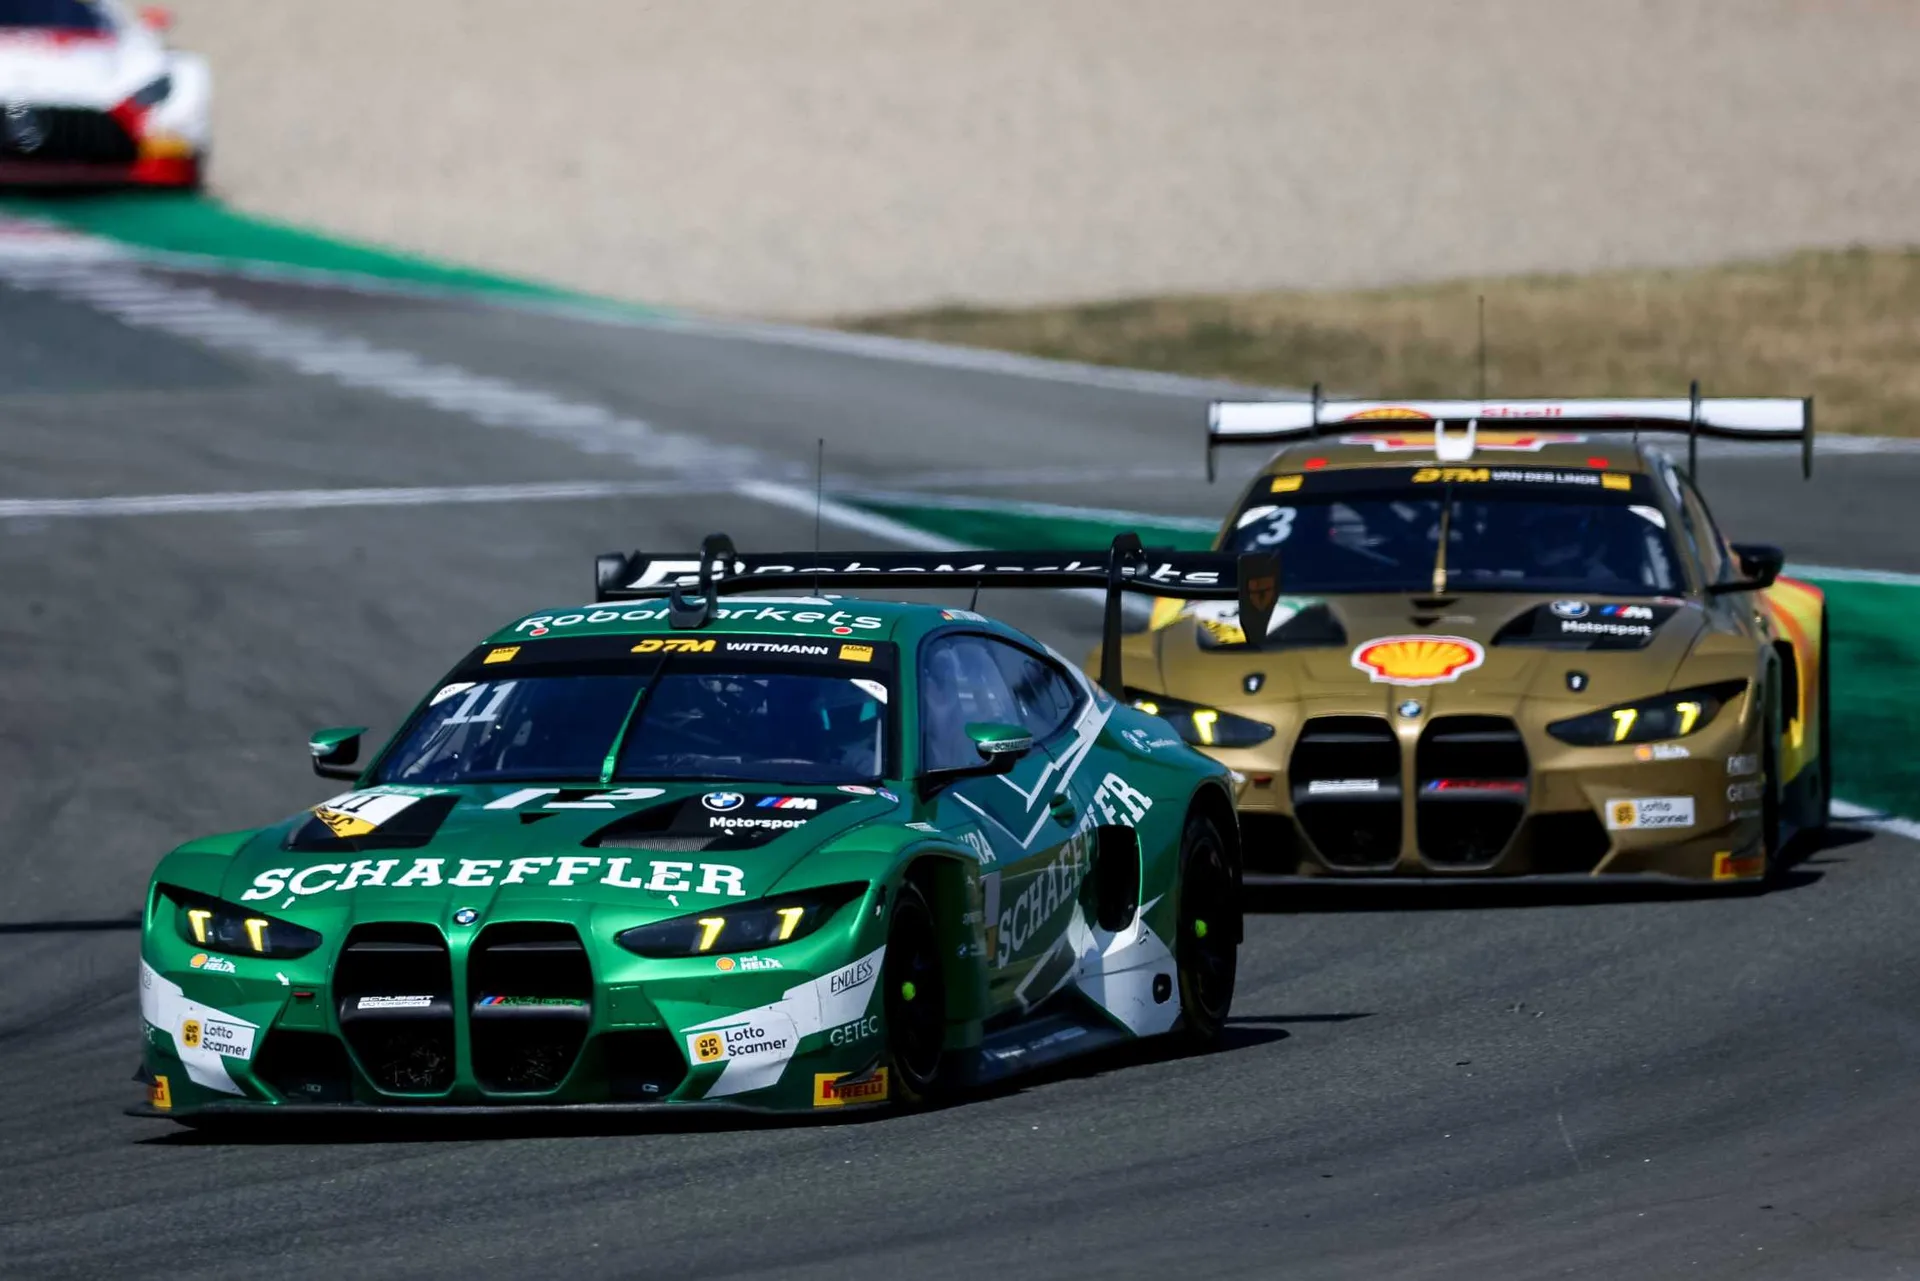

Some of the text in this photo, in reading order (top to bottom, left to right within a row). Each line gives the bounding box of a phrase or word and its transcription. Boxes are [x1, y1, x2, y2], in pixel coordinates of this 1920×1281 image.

[1411, 468, 1599, 485] DTM VAN DER LINDE
[1256, 506, 1298, 545] 3
[515, 606, 882, 632] Roboarkets
[1562, 620, 1652, 636] Motorsport
[631, 639, 829, 655] DTM WITTMANN
[441, 681, 518, 725] 11
[1639, 802, 1672, 812] Lotto
[709, 816, 807, 830] Motorsport
[1640, 813, 1689, 825] Scanner
[241, 856, 747, 901] SCHAEFFLER
[740, 958, 784, 970] HELIX
[830, 957, 873, 994] ENDLESS
[204, 1023, 234, 1039] Lotto
[725, 1026, 765, 1043] Lotto
[829, 1015, 879, 1046] GETEC
[202, 1038, 247, 1056] Scanner
[727, 1038, 788, 1057] Scanner
